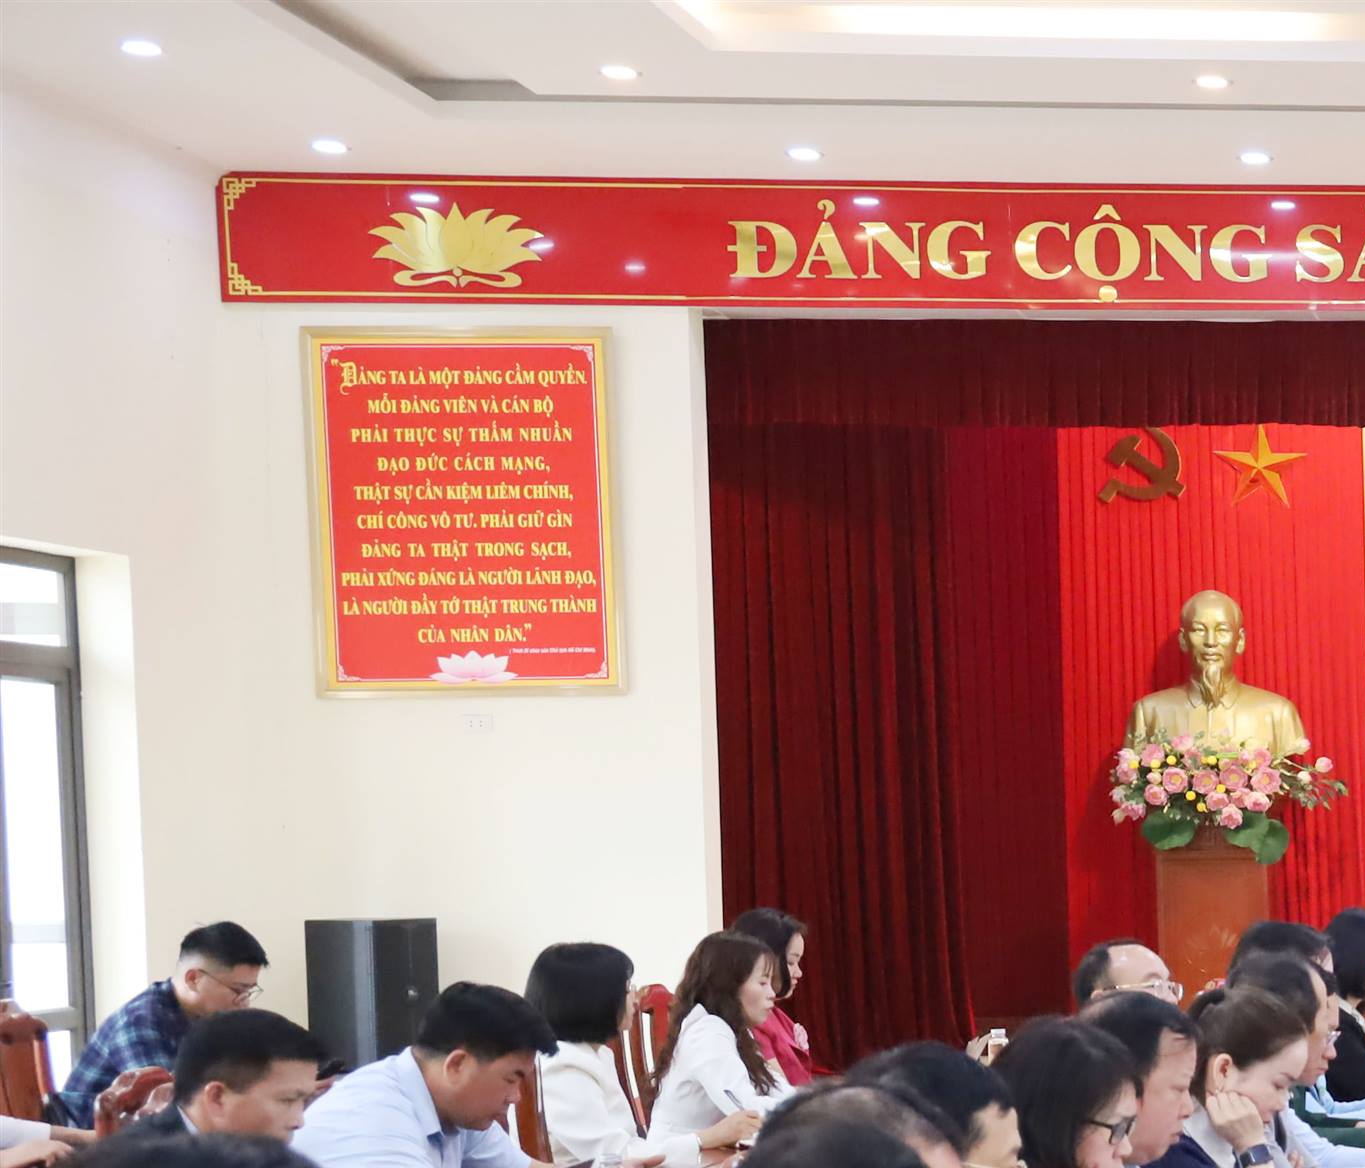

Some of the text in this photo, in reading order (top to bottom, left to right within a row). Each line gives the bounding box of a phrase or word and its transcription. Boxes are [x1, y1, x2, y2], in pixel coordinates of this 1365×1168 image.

[726, 199, 989, 281] ĐẢNG
[1014, 205, 1269, 303] CỘNG
[389, 371, 406, 385] TA
[409, 367, 426, 384] LÀ
[429, 367, 461, 389] MỘT
[463, 366, 502, 384] ĐẢNG
[505, 363, 535, 384] CẦM
[368, 394, 553, 417] MỖI ĐẢNG VIÊN VÀ CÁN BỘ
[351, 424, 388, 442] PHẢI
[394, 427, 436, 446] THỰC
[443, 427, 463, 446] SỰ
[377, 457, 409, 475] ĐẠO
[416, 453, 447, 471] ĐỨC
[454, 453, 495, 471] CÁCH
[354, 479, 573, 504] THẬT SỰ CẦN KIỆM LIÊM CHÍNH,
[357, 509, 572, 529] CHÍ CÔNG VÔ TƯ. PHẢI GIỮ GÌN
[362, 540, 571, 561] ĐẢNG TA THẬT TRONG SẠCH,
[342, 567, 596, 588] PHẢI XỨNG ĐÁNG LÀ NGƯỜI LÃNH ĐẠO,
[344, 597, 360, 615] LÀ
[363, 597, 408, 615] NGƯỜI
[440, 596, 460, 614] TỚ
[462, 596, 498, 618] THẬT
[501, 599, 547, 613] TRUNG
[550, 595, 597, 612] THÀNH
[418, 625, 488, 643] CỦA NHÂN
